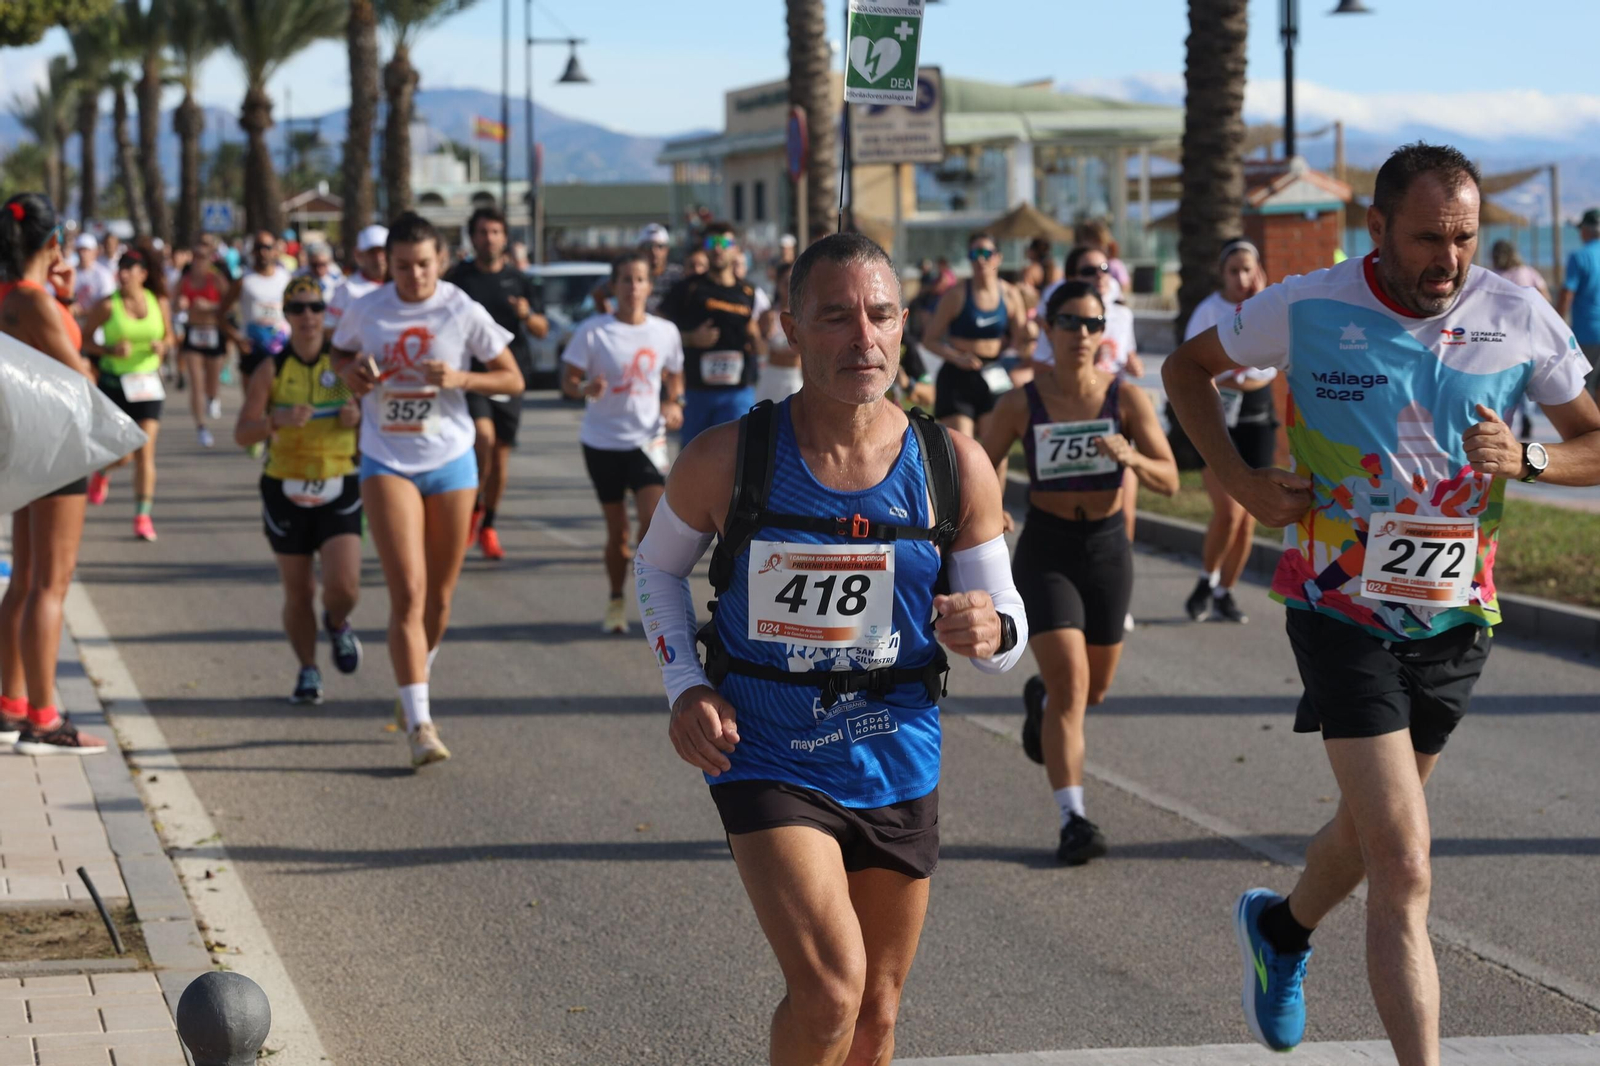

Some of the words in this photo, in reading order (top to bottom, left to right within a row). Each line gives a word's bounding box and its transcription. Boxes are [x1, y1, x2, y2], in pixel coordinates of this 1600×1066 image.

[890, 77, 912, 89] DEA
[1311, 371, 1388, 388] Málaga
[1316, 387, 1365, 402] 2025
[386, 401, 431, 421] 352
[1049, 434, 1103, 462] 755
[1381, 538, 1466, 578] 272
[1367, 581, 1388, 593] 024
[775, 574, 871, 616] 418
[759, 622, 780, 634] 024
[855, 647, 875, 657] SAN
[855, 655, 896, 665] SILVESTRE
[855, 714, 890, 728] AEDAS
[855, 722, 890, 736] HOMES
[790, 728, 844, 753] mayoral
